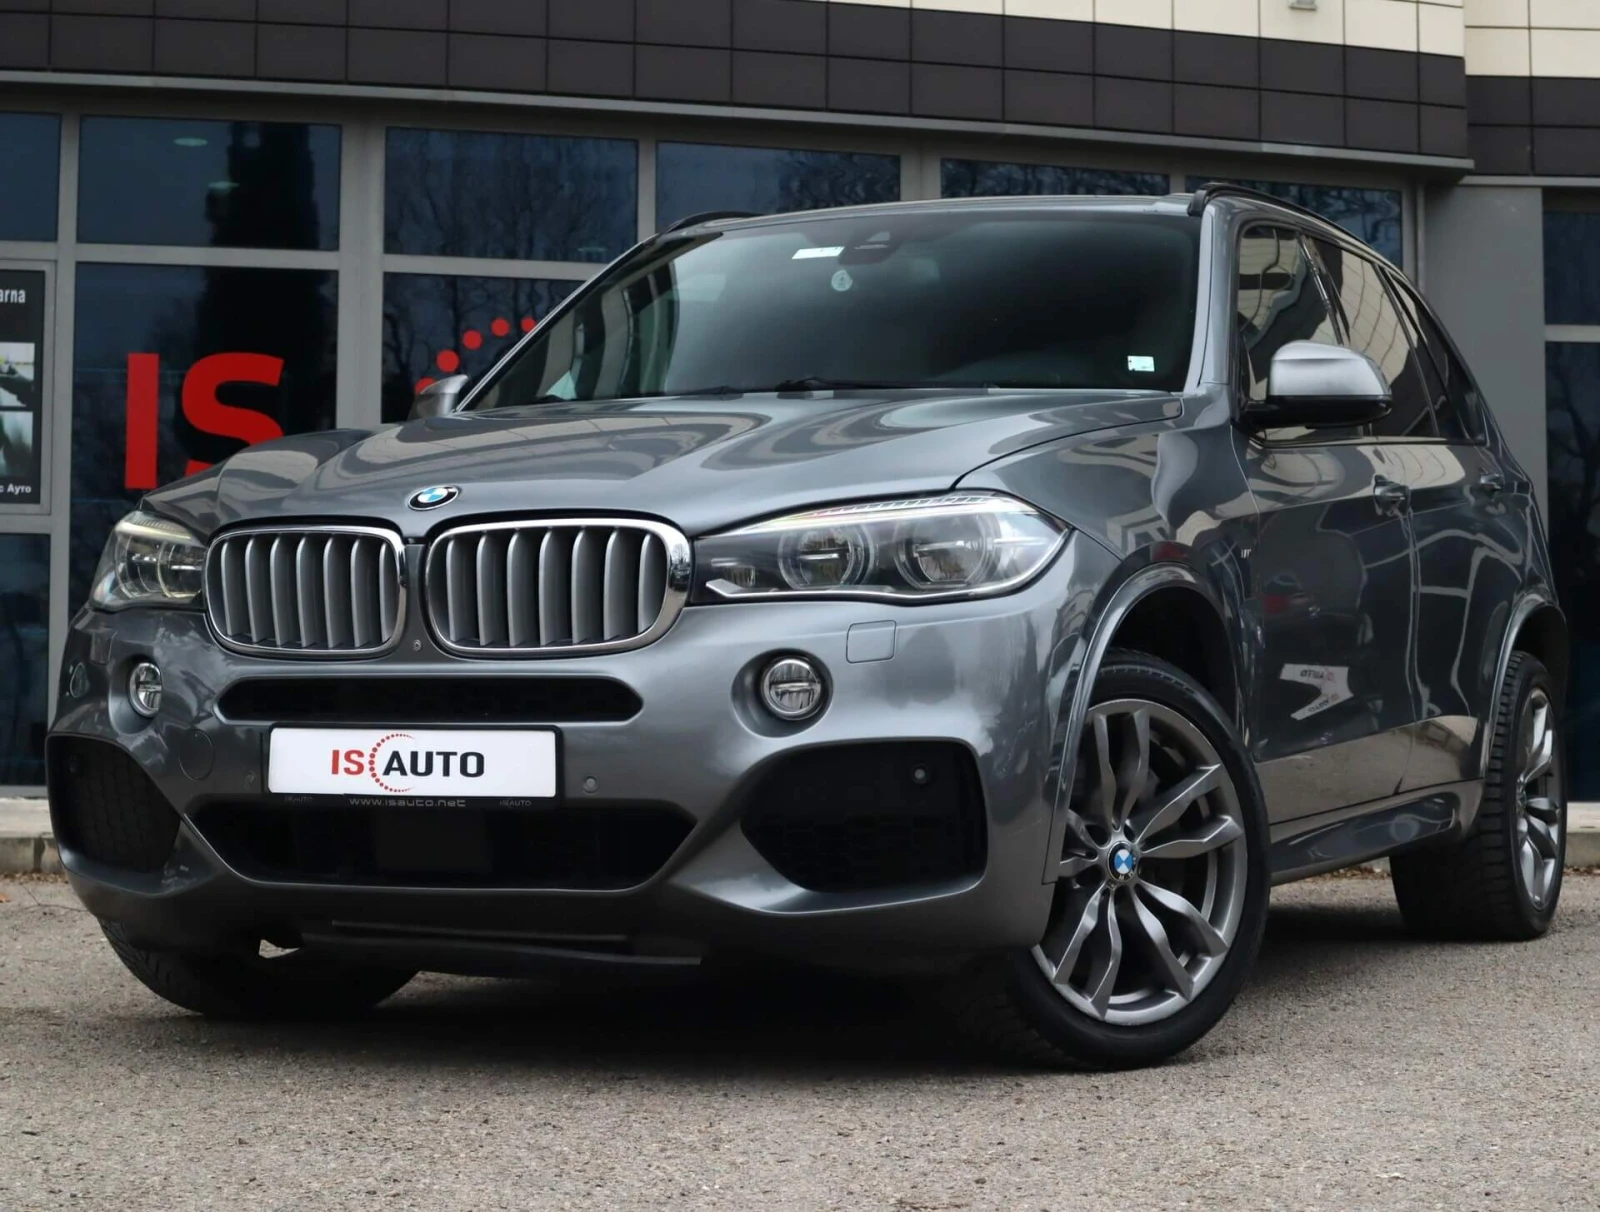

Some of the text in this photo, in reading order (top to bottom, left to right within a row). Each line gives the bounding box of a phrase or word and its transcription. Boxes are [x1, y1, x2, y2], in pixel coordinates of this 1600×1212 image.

[124, 352, 285, 490] IS
[331, 749, 485, 778] IS AUTO
[349, 798, 466, 808] www.isauto.net
